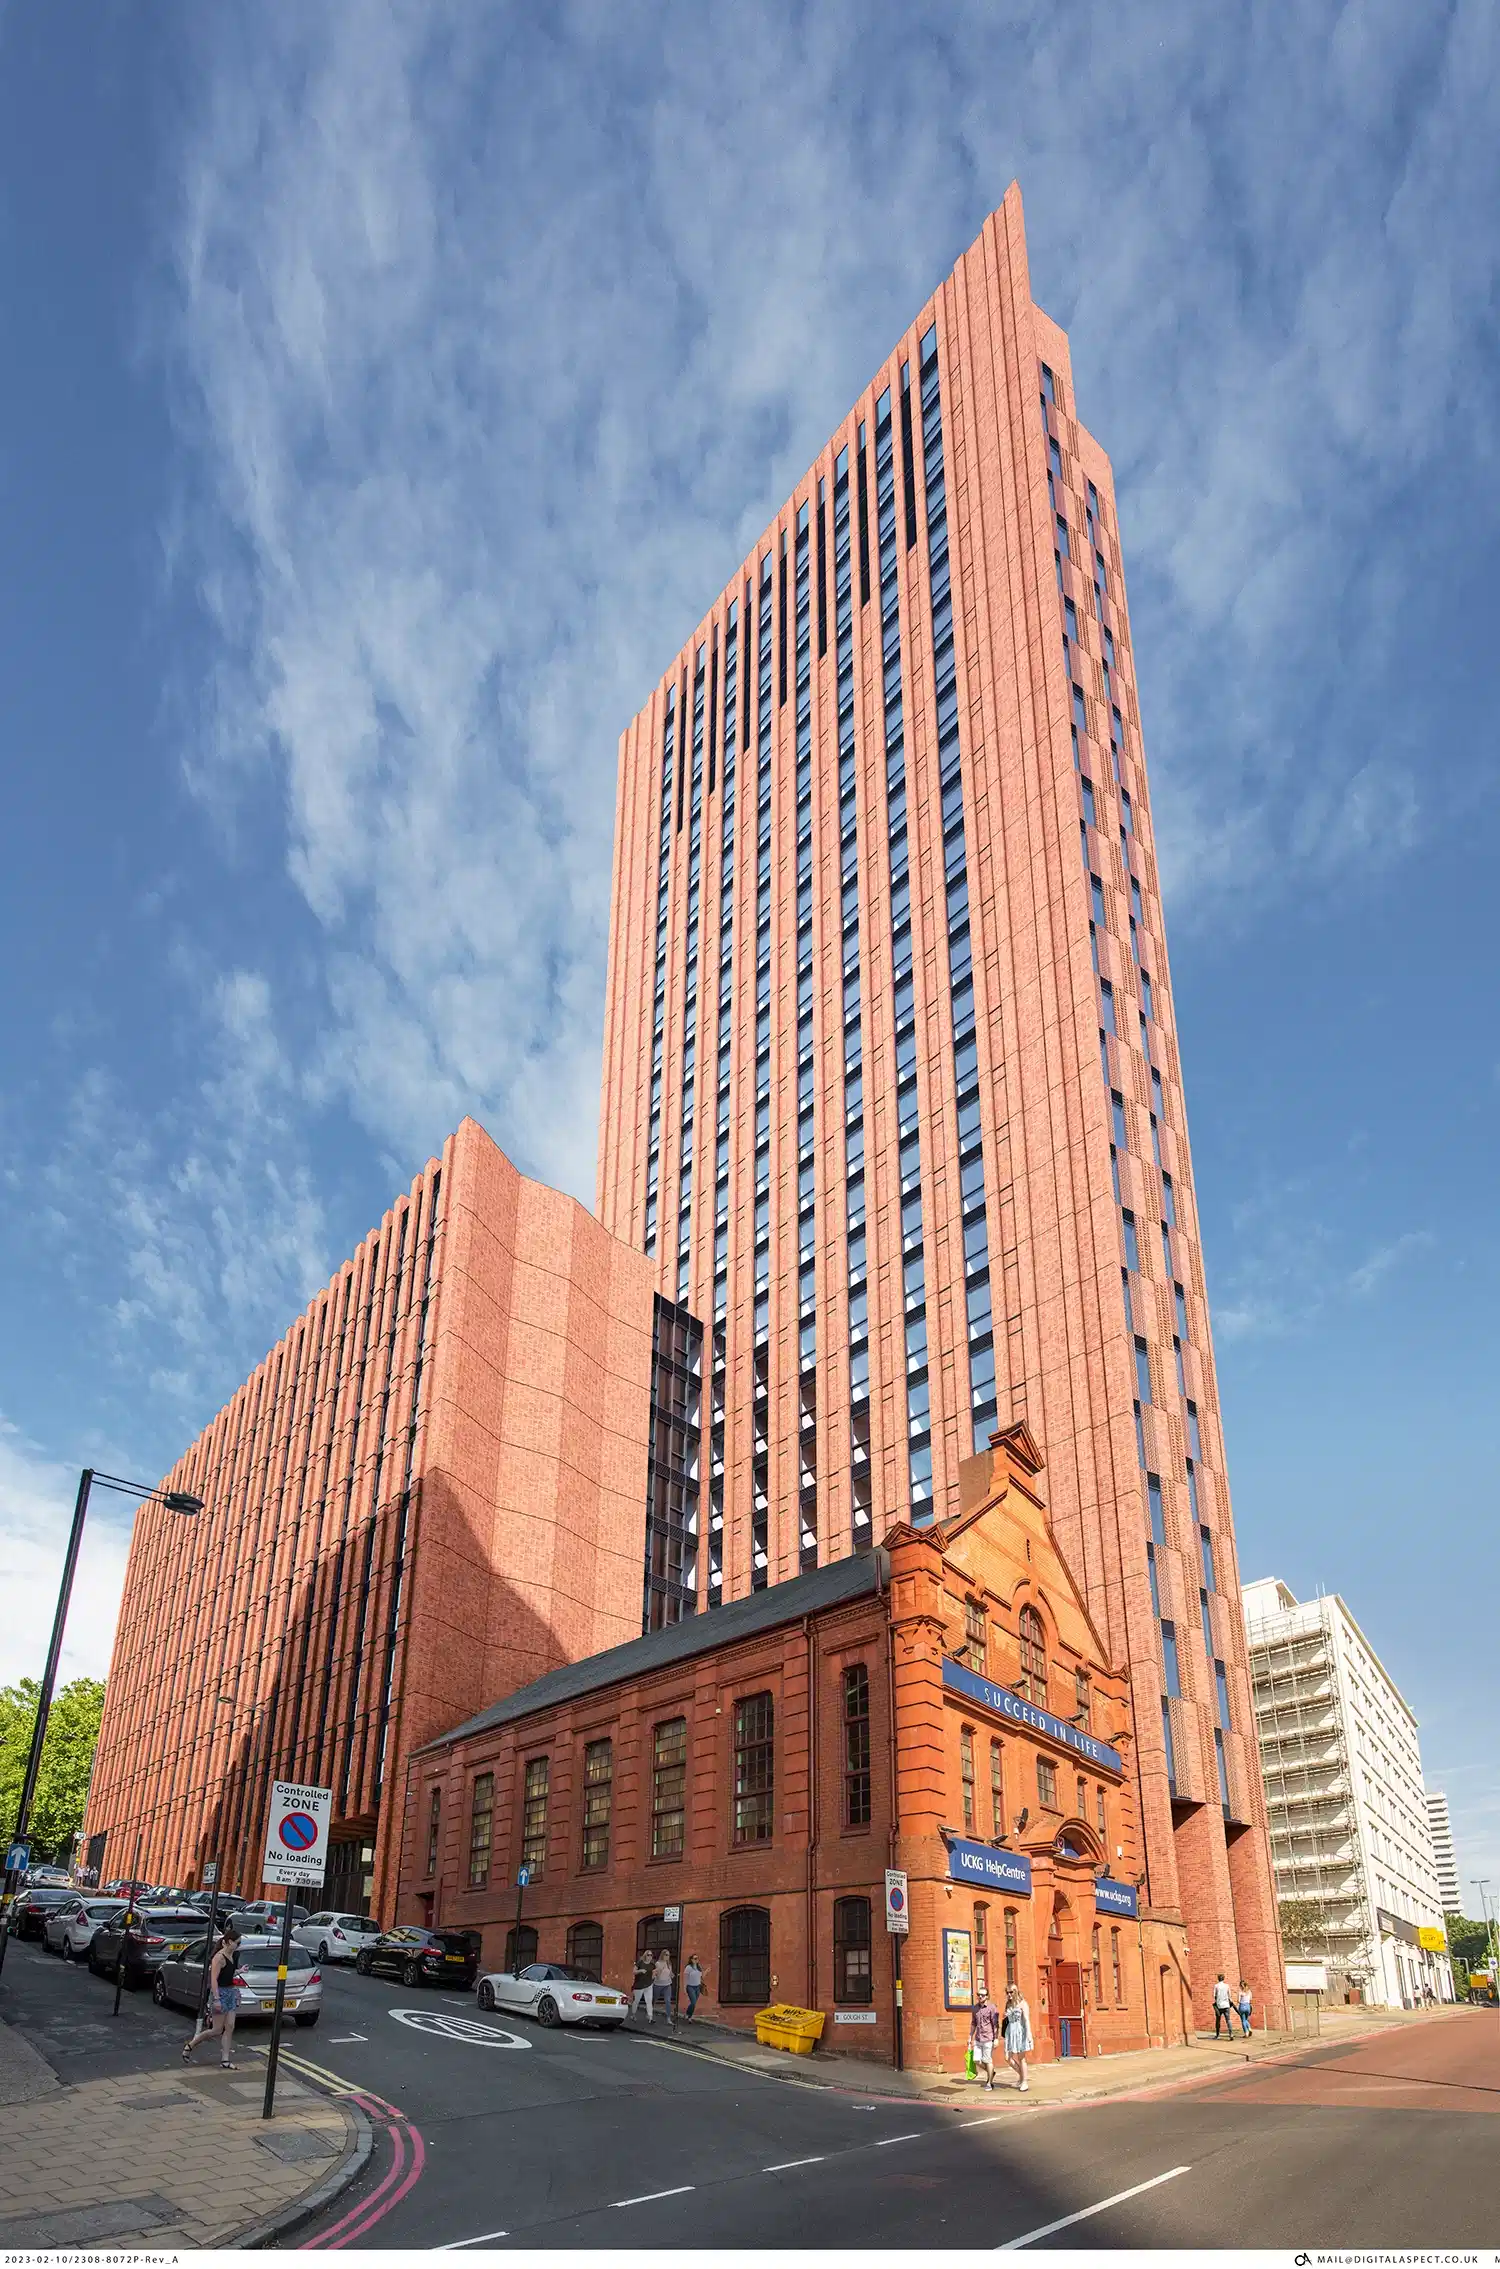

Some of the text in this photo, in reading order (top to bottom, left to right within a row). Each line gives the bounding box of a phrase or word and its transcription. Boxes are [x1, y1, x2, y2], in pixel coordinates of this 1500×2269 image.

[984, 1686, 1099, 1758] SUCCEED IN LIFE
[276, 1784, 329, 1800] Controlled
[282, 1797, 320, 1812] ZONE
[268, 1850, 323, 1866] No loading
[279, 1868, 311, 1878] Every day
[961, 1852, 1026, 1881] UCKG HelpCentre
[295, 1877, 311, 1885] 7.30
[311, 1879, 322, 1887] pm
[1095, 1887, 1132, 1907] www.uckg.org
